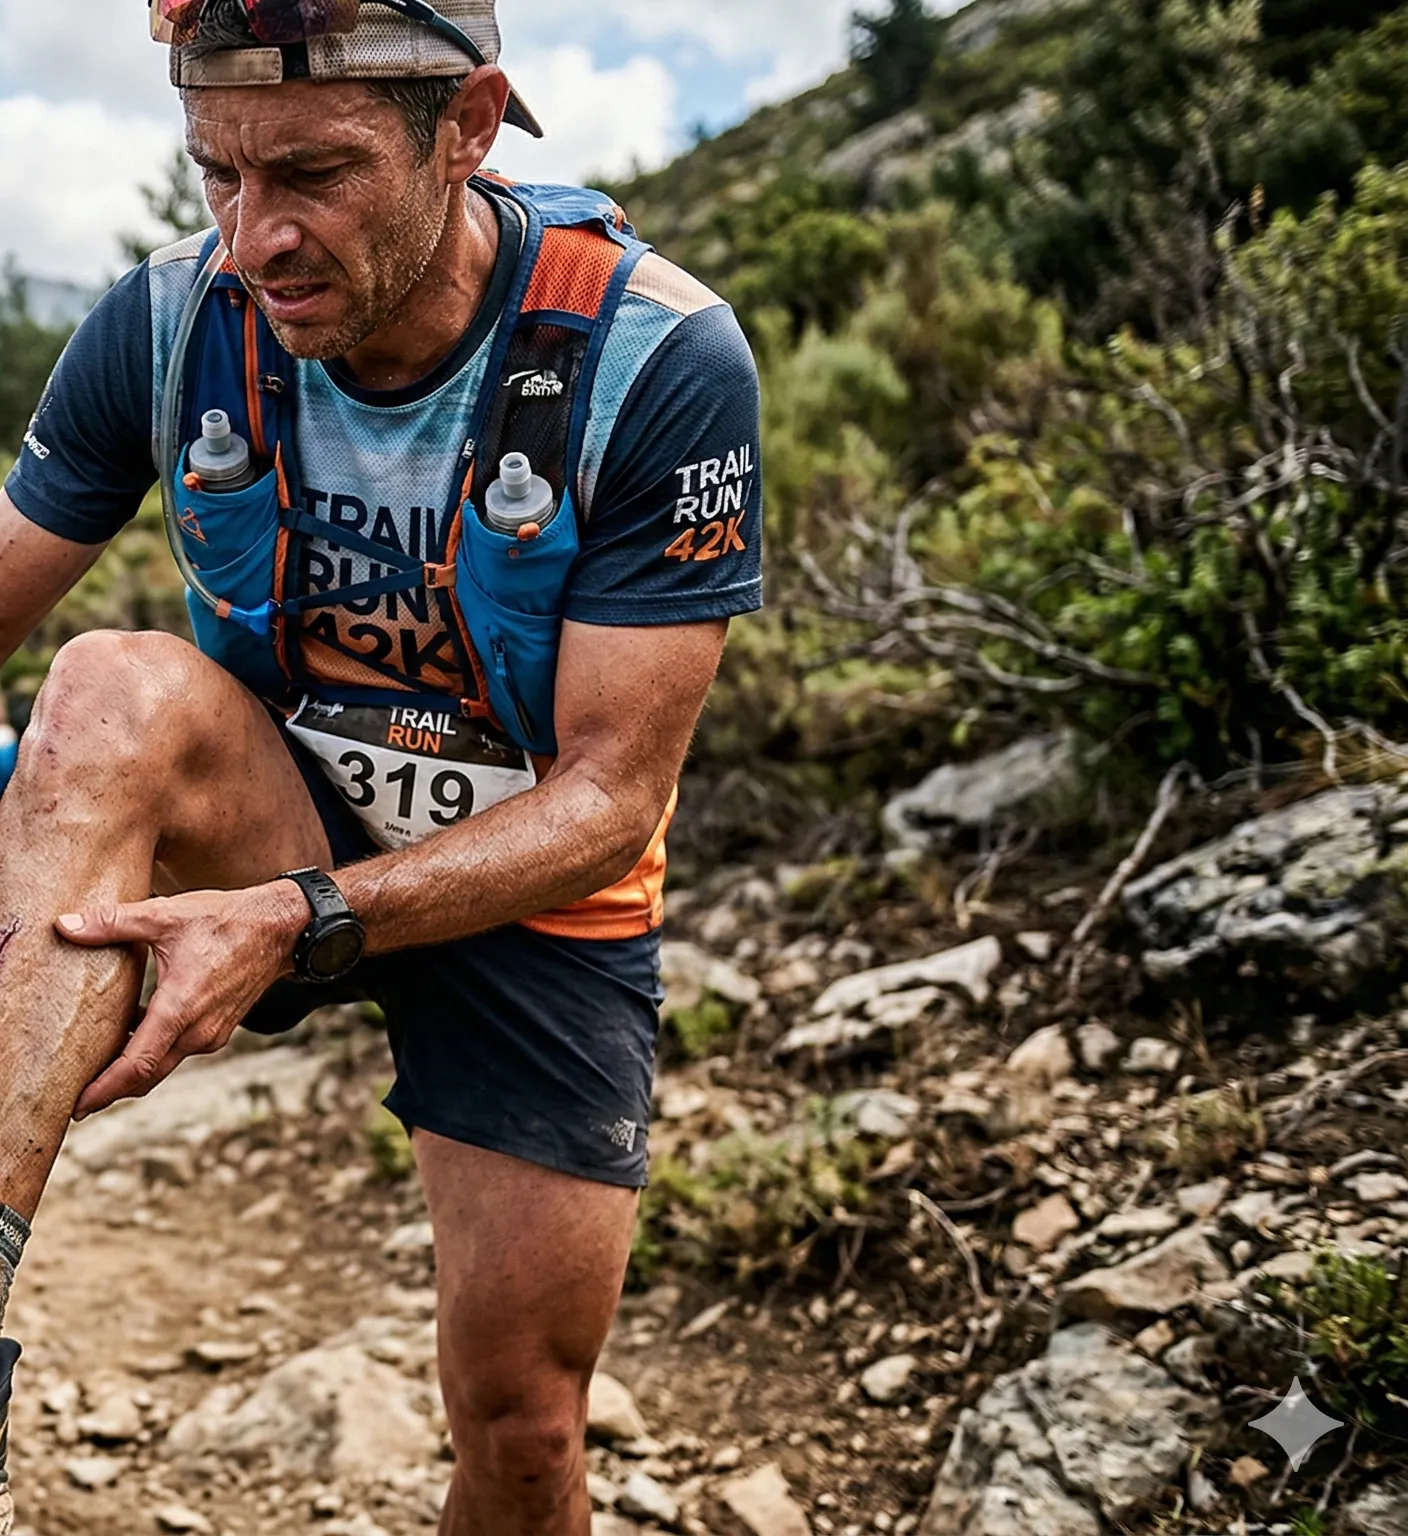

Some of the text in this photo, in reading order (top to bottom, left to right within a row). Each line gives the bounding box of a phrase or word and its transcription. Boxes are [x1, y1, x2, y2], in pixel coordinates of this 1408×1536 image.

[674, 443, 754, 494] TRAIL
[664, 509, 746, 563] 42K
[388, 725, 441, 754] RUN
[389, 706, 457, 735] TRAIL
[337, 751, 474, 827] 319
